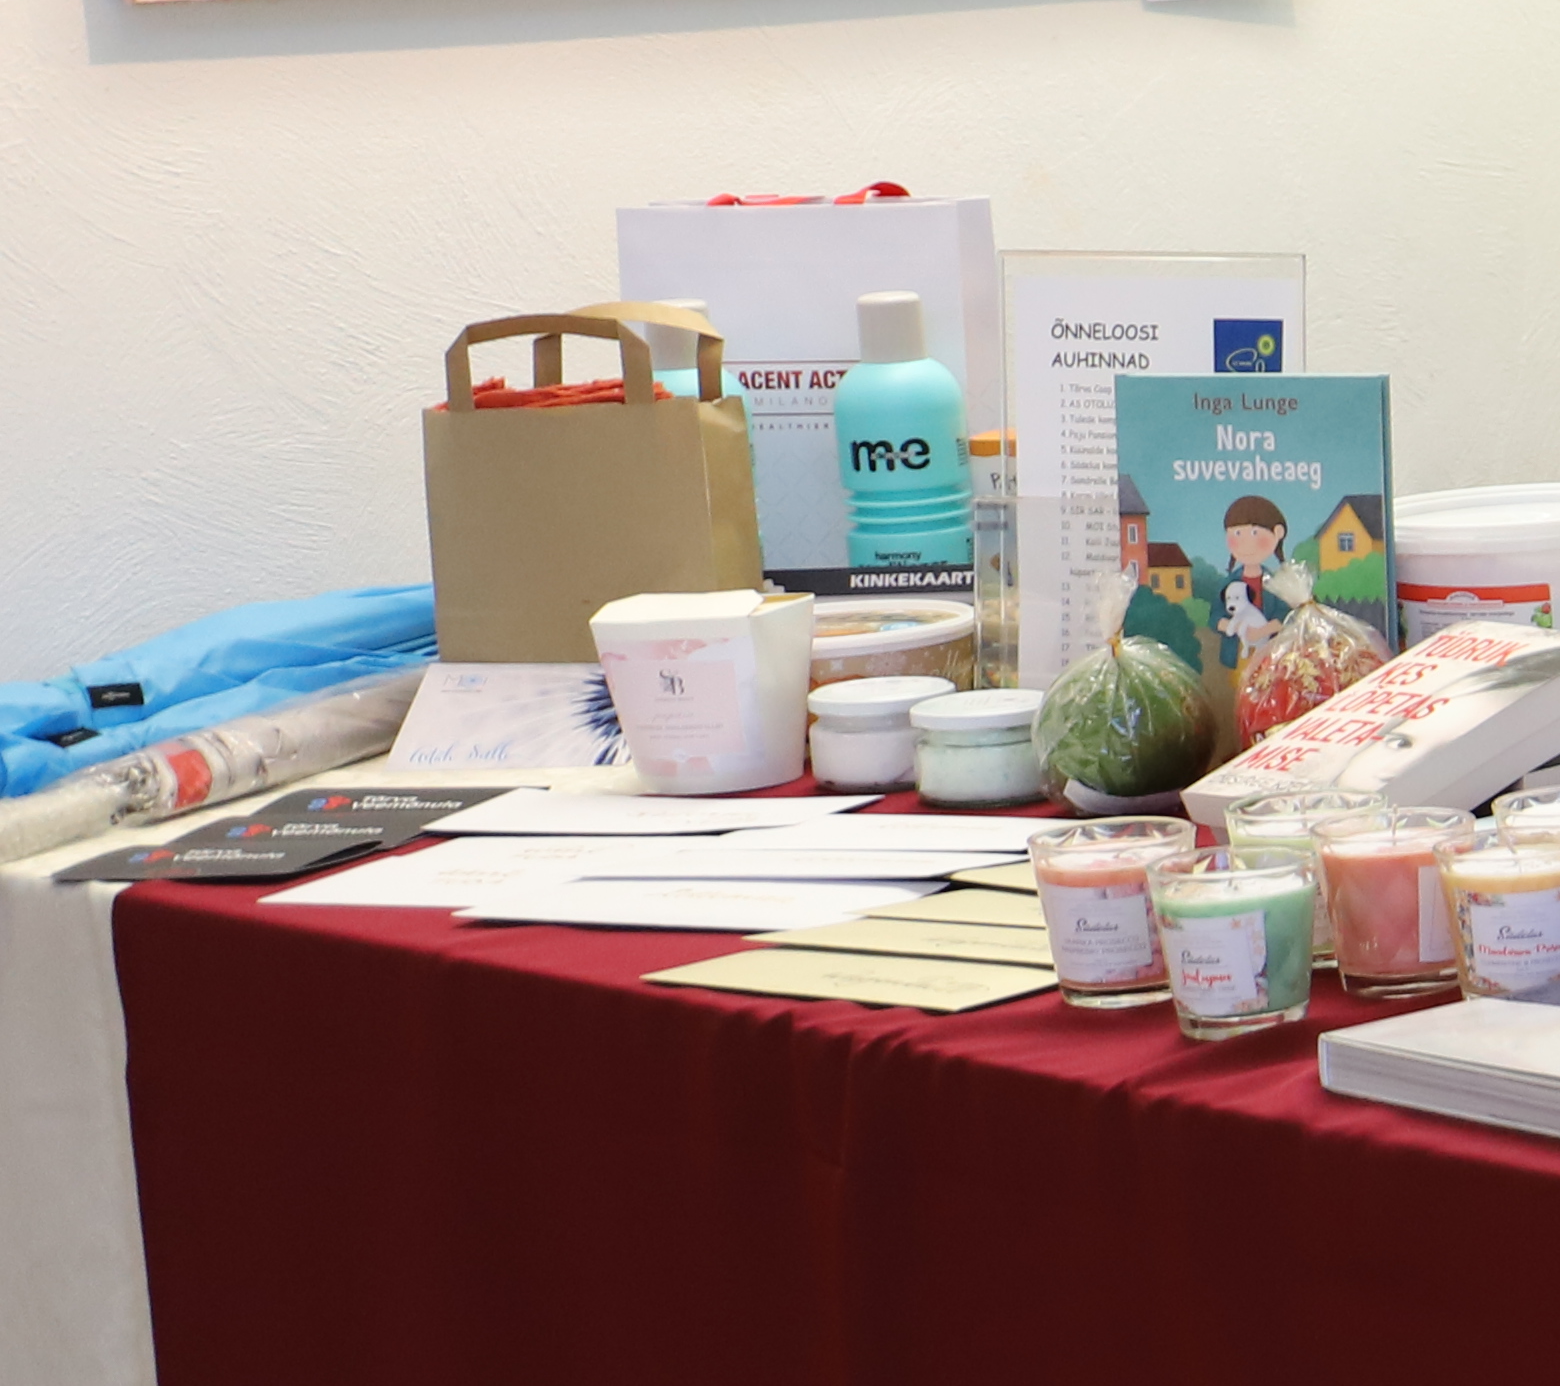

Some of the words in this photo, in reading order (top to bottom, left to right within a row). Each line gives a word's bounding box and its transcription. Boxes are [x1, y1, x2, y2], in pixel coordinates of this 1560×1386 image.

[1050, 317, 1159, 341] ÕNNELOOSI
[1051, 351, 1150, 370] AUHINNAD
[754, 396, 829, 406] MILANO
[1194, 392, 1232, 415] Inga
[1241, 392, 1299, 416] Lunge
[1216, 424, 1276, 451] Nora
[850, 437, 931, 472] me
[1172, 454, 1322, 490] suvevaheaeg
[850, 571, 975, 589] KINKEKAART
[1369, 661, 1438, 687] KES
[1233, 744, 1321, 773] MISE
